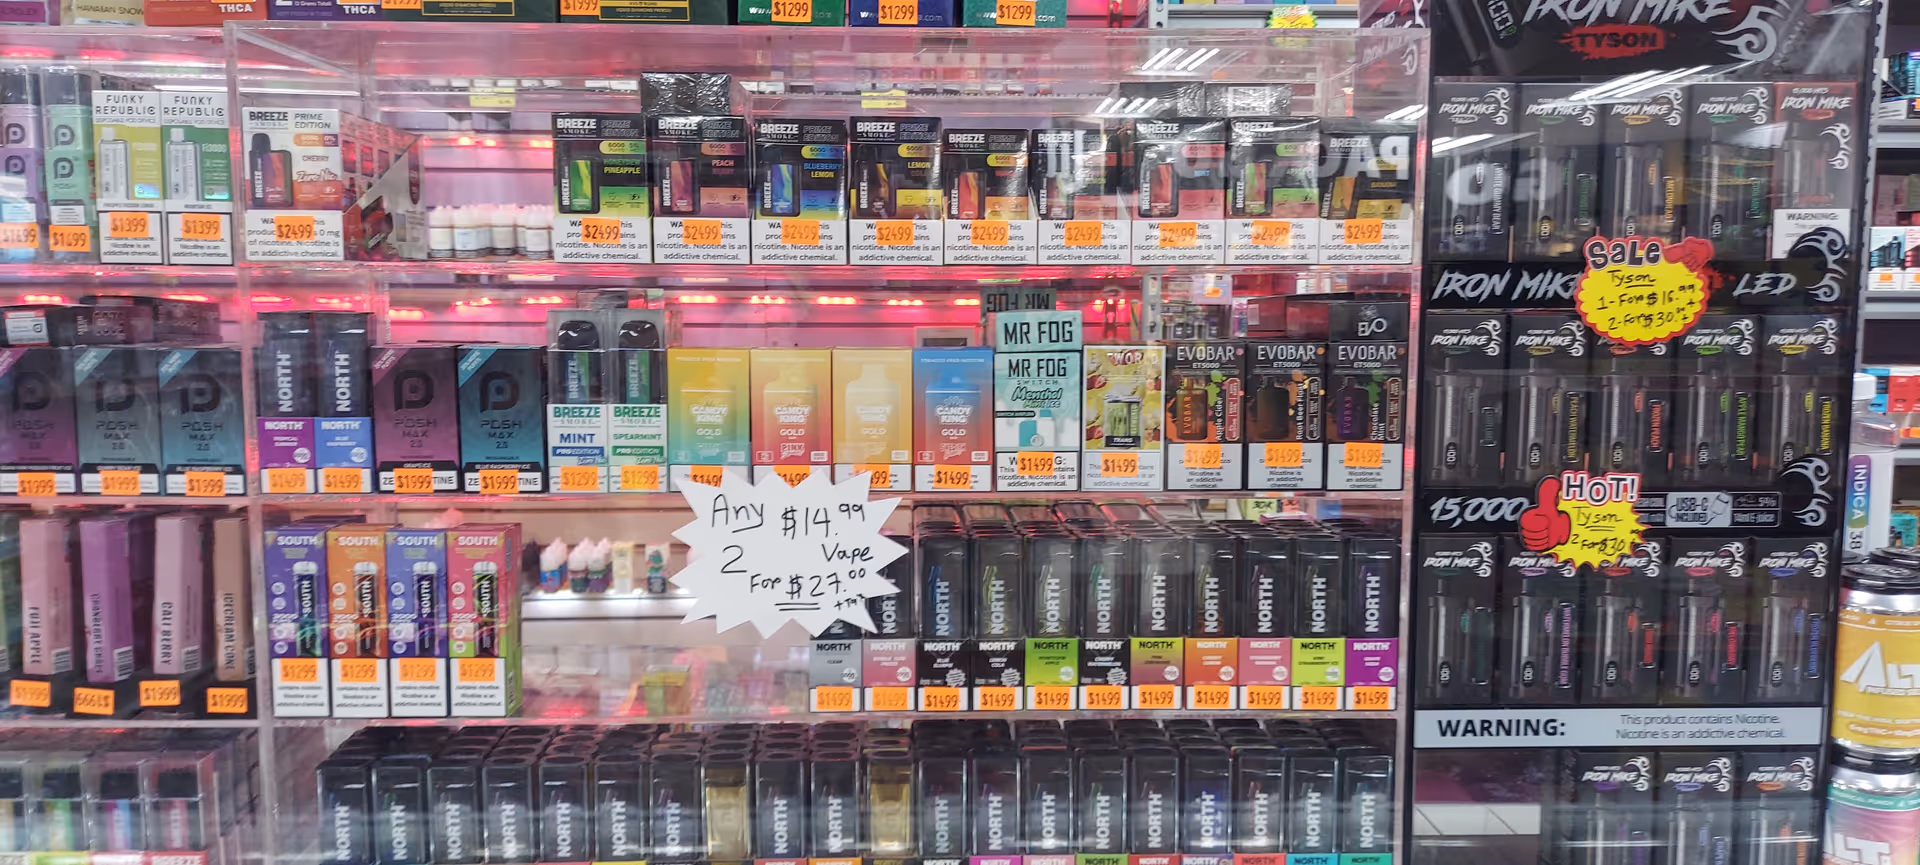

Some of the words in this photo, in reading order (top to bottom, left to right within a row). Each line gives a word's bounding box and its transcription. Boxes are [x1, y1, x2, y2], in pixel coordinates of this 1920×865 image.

[218, 4, 253, 13] THCA
[342, 5, 377, 15] THCA
[773, 2, 808, 18] $1299
[880, 4, 914, 20] $1299
[998, 4, 1032, 20] $1299
[1522, 0, 1628, 26] IRON
[1629, 0, 1732, 26] MIKE
[1577, 31, 1658, 48] TYSON
[106, 95, 144, 104] FUNKY
[174, 96, 212, 105] FUNKY
[1780, 98, 1811, 110] IRON
[1813, 97, 1851, 109] MIKE
[96, 106, 156, 116] REPUBLIC
[164, 107, 225, 117] REPUBLIC
[249, 111, 288, 121] BREEZE
[1440, 104, 1469, 115] IRON
[1468, 104, 1496, 114] MIKE
[295, 113, 323, 121] PRIME
[557, 118, 596, 129] BREEZE
[294, 121, 331, 129] EDITION
[658, 119, 698, 130] BREEZE
[760, 123, 799, 134] BREEZE
[857, 122, 895, 132] BREEZE
[1330, 138, 1369, 148] BREEZE
[604, 166, 640, 174] PINEAPPLE
[1786, 212, 1839, 221] WARNING:
[111, 217, 147, 233] $1399
[183, 220, 219, 235] $1399
[277, 225, 313, 239] $2499
[684, 224, 720, 240] $2499
[584, 225, 619, 240] $2499
[877, 225, 912, 241] $2499
[972, 225, 1007, 241] $2499
[1065, 225, 1100, 241] $2499
[1346, 225, 1381, 240] $2499
[261, 249, 296, 257] addictive
[298, 249, 340, 258] chemical.
[563, 252, 597, 260] addictive
[599, 252, 640, 260] chemical.
[954, 254, 987, 262] addictive
[990, 254, 1028, 262] chemical.
[1607, 270, 1656, 288] Tyson
[1733, 273, 1797, 296] LED
[1432, 273, 1509, 300] IRON
[1004, 324, 1030, 345] MR
[1038, 322, 1073, 343] FOG
[1177, 346, 1235, 362] EVOBAR
[1257, 345, 1315, 361] EVOBAR
[1338, 345, 1397, 361] EVOBAR
[1008, 359, 1034, 377] MR
[1037, 358, 1067, 377] FOG
[278, 353, 293, 412] NORTH
[336, 353, 350, 412] NORTH
[1011, 387, 1063, 402] Menthol
[1295, 383, 1303, 404] Float
[553, 406, 600, 418] BREEZE
[613, 406, 660, 418] BREEZE
[936, 406, 972, 416] CANDY
[1215, 396, 1223, 417] Cider
[941, 415, 967, 424] KING
[1295, 405, 1303, 423] Beer
[265, 422, 304, 430] NORTH
[321, 422, 361, 430] NORTH
[480, 420, 521, 429] POSH
[1370, 402, 1379, 441] Chocolate
[488, 431, 515, 439] MAX
[780, 428, 805, 436] GOLD
[1215, 418, 1223, 441] Apple
[1295, 424, 1303, 440] Root
[1378, 422, 1386, 441] Mint
[560, 433, 595, 444] MINT
[613, 433, 662, 441] SPEARMINT
[1347, 449, 1381, 463] $1499
[1020, 456, 1053, 471] $1499
[1103, 459, 1137, 473] $1499
[397, 474, 432, 490] $1999
[482, 475, 517, 490] $1999
[562, 472, 597, 486] $1299
[623, 470, 658, 484] $1299
[935, 470, 969, 485] $1499
[19, 480, 54, 493] $1999
[188, 480, 224, 493] $1999
[1852, 463, 1866, 521] INDICA
[1676, 497, 1709, 512] USB-C
[711, 493, 764, 533] Any
[1430, 497, 1528, 528] 15,000
[1572, 506, 1623, 527] Tyson
[277, 537, 317, 546] SOUTH
[338, 537, 378, 546] SOUTH
[397, 537, 437, 546] SOUTH
[458, 537, 498, 546] SOUTH
[1571, 533, 1579, 545] 2
[1849, 531, 1862, 551] 38
[720, 545, 747, 574] 2
[822, 542, 874, 564] Vape
[750, 574, 781, 593] For
[936, 581, 949, 636] NORTH
[1152, 575, 1166, 631] NORTH
[1258, 577, 1273, 633] NORTH
[1365, 576, 1380, 632] NORTH
[816, 643, 851, 651] NORTH
[1034, 642, 1069, 650] NORTH
[1139, 641, 1174, 649] NORTH
[341, 664, 376, 678] $1299
[143, 687, 177, 701] $1999
[211, 694, 245, 707] $1999
[1036, 692, 1069, 705] $1499
[1196, 691, 1228, 704] $1499
[925, 695, 958, 708] $1499
[1438, 718, 1567, 738] WARNING:
[1620, 714, 1642, 725] This
[1643, 715, 1684, 728] product
[1686, 714, 1732, 725] contains
[1734, 714, 1781, 725] Nicotine.
[1616, 728, 1660, 739] Nicotine
[1661, 728, 1671, 739] is
[1673, 730, 1686, 739] an
[1687, 728, 1734, 739] addictive
[1736, 728, 1786, 739] chemical.
[828, 799, 842, 853] NORTH
[989, 796, 1003, 850] NORTH
[336, 805, 349, 861] NORTH
